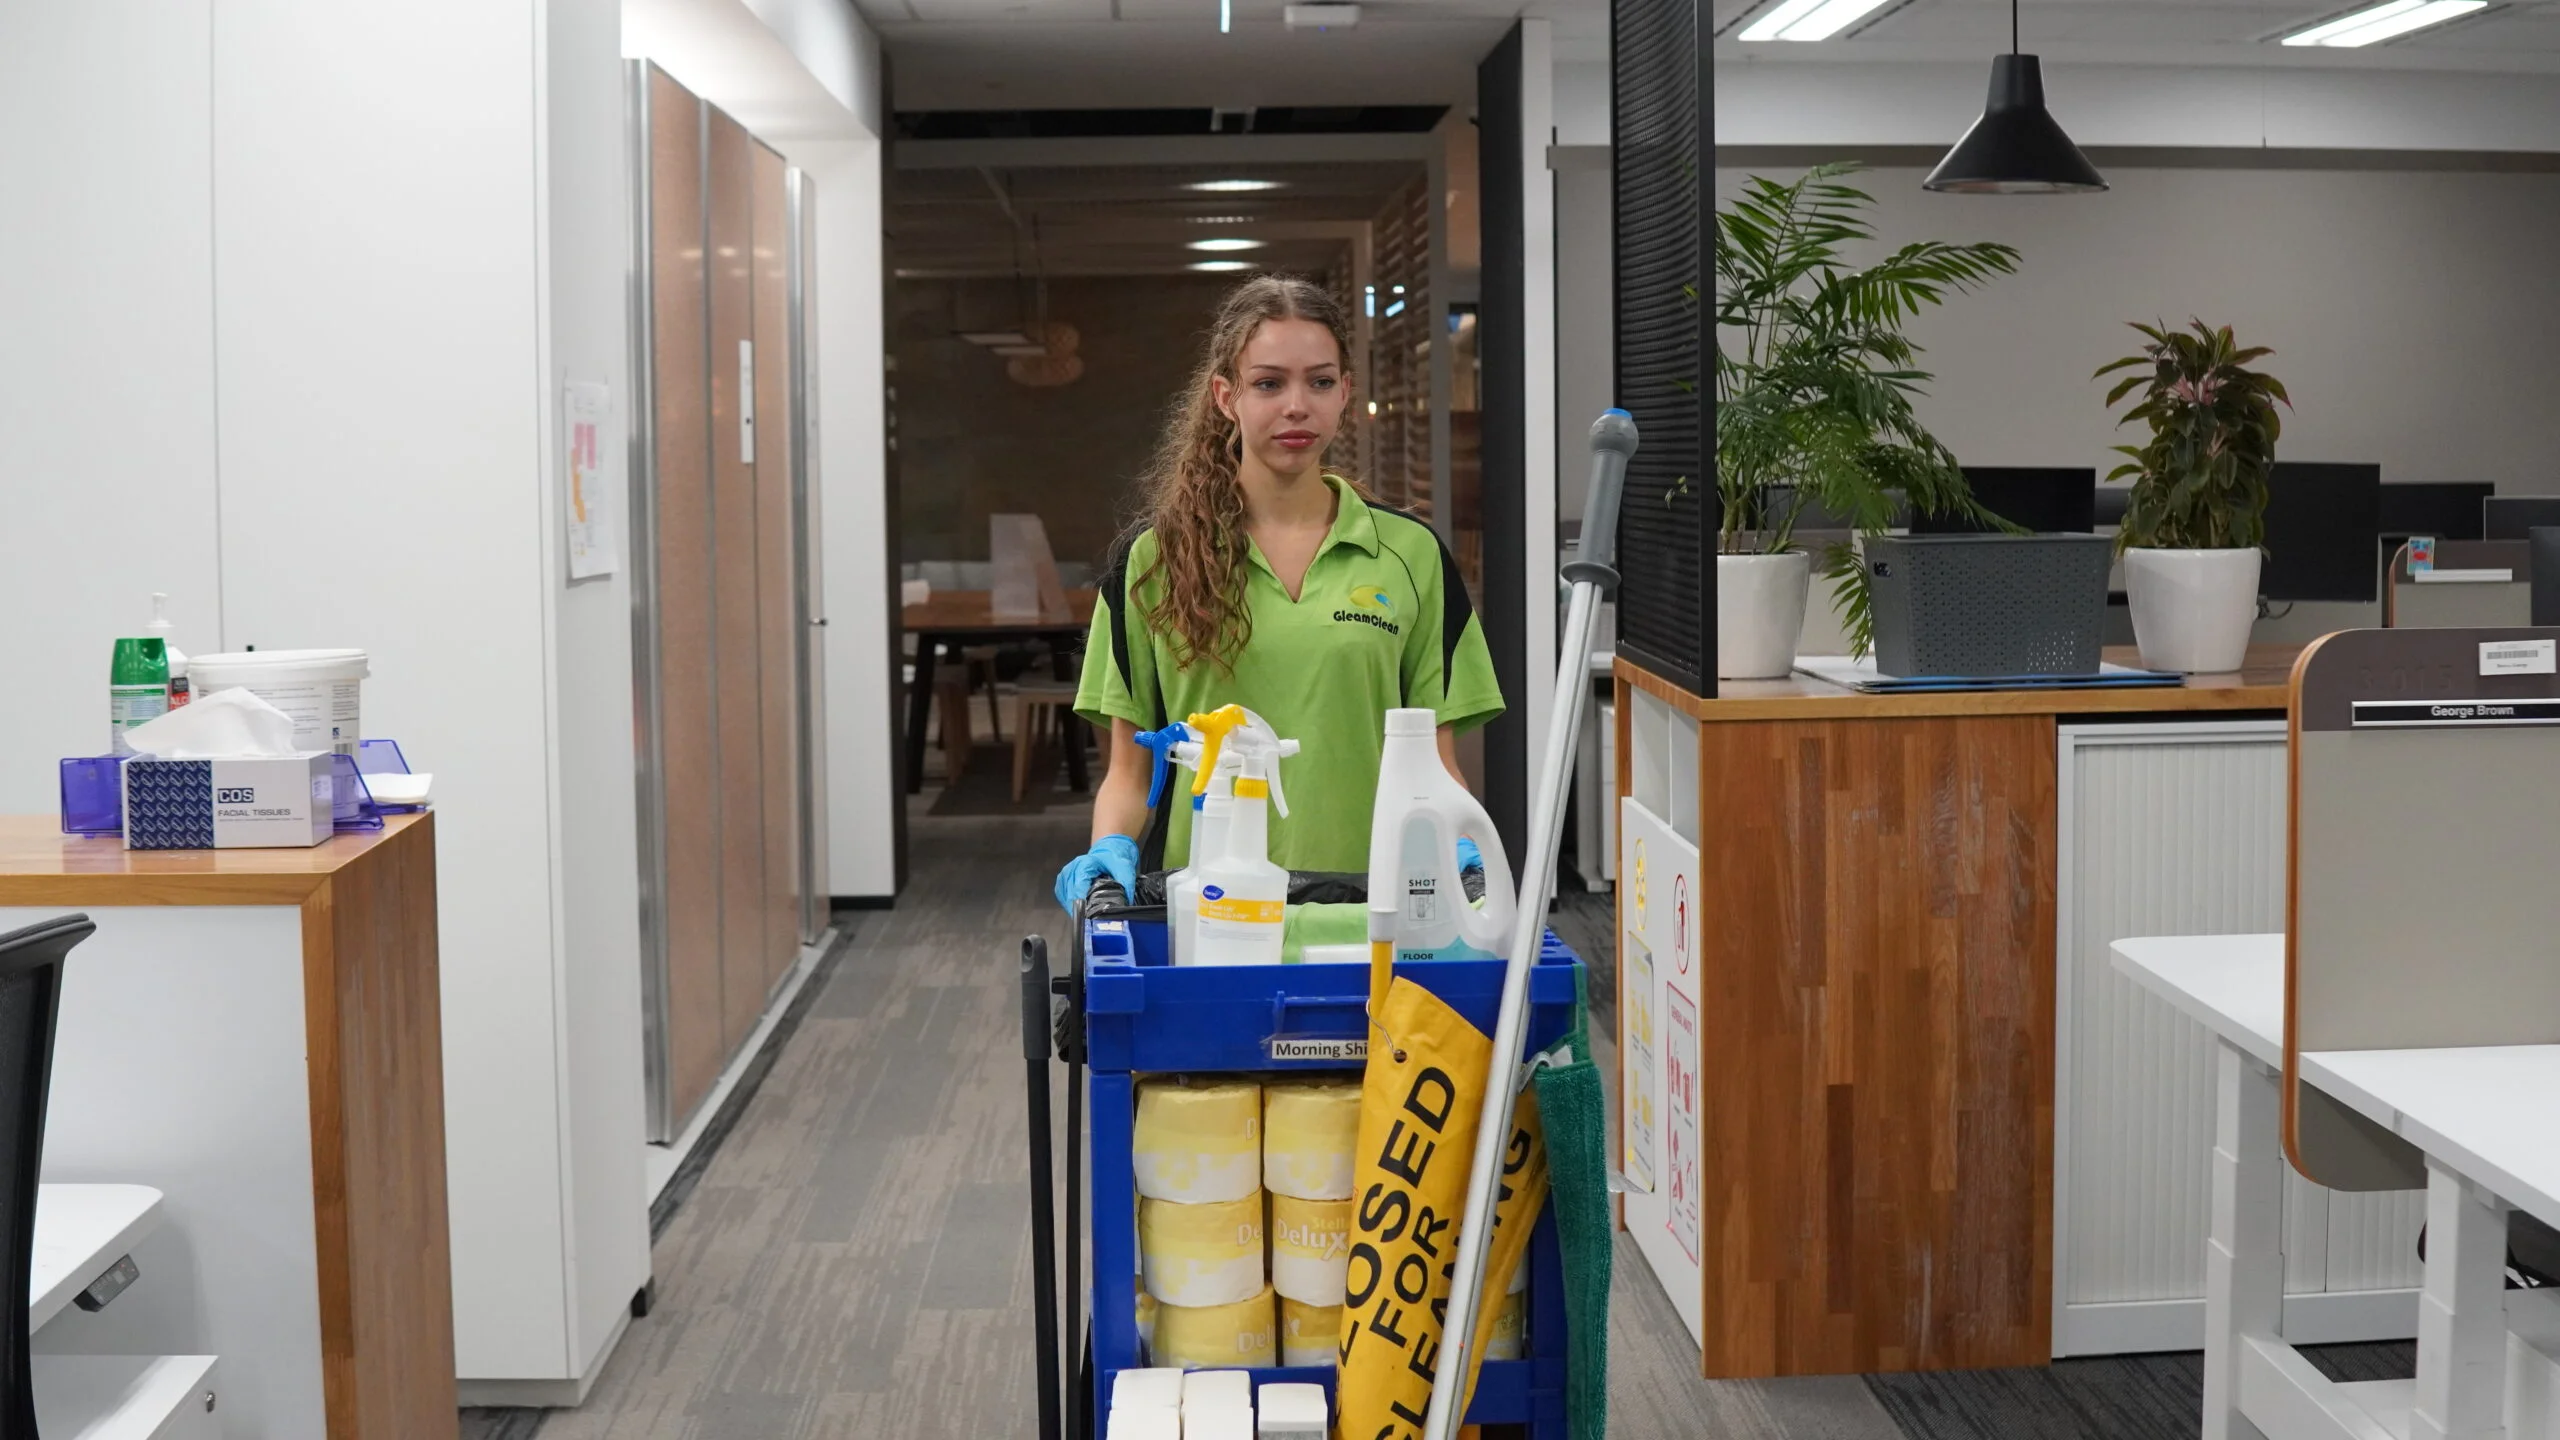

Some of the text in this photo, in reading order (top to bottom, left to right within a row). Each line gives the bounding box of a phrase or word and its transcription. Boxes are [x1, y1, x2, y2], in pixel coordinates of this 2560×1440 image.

[2431, 705, 2514, 718] George Brown
[220, 789, 254, 803] COS
[253, 808, 291, 816] TISSUES
[1408, 878, 1437, 887] SHOT
[1403, 953, 1434, 961] FLOOR
[1276, 1043, 1341, 1058] Morning
[1335, 1066, 1456, 1428] LOSED
[1369, 1204, 1450, 1348] FOR
